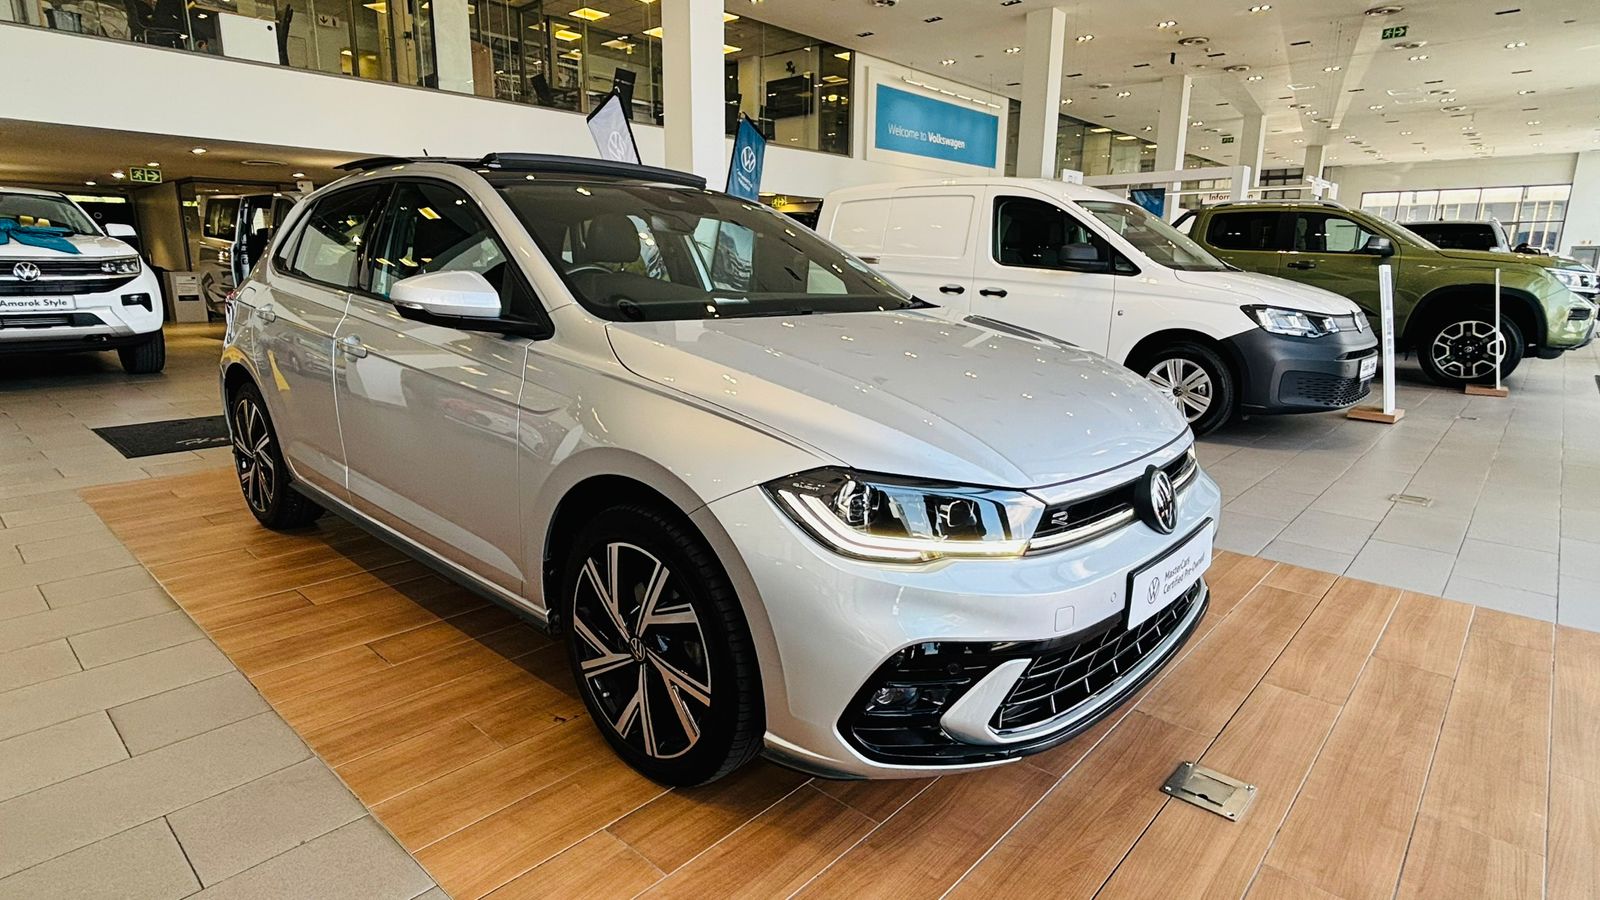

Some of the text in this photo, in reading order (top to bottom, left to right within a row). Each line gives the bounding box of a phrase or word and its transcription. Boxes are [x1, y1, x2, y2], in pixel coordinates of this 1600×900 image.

[888, 122, 966, 150] Welcome to Volkswagen
[0, 298, 67, 307] Amarok Style
[1163, 574, 1184, 594] Certified
